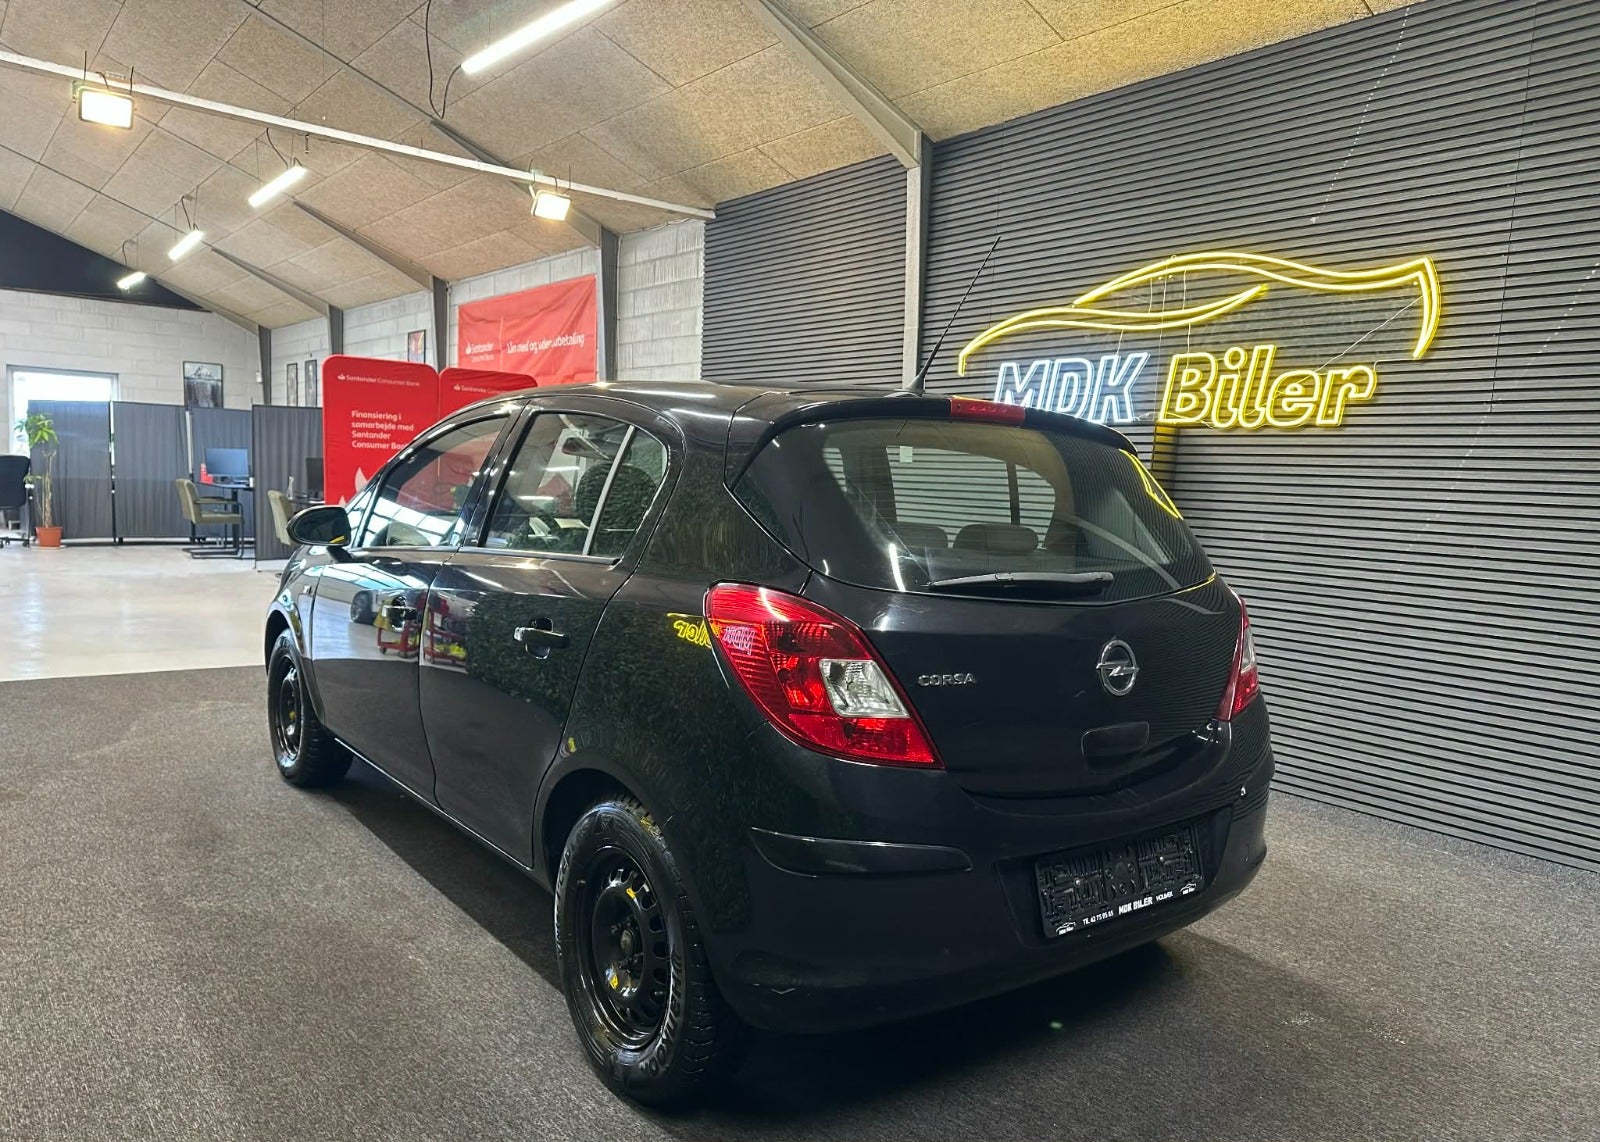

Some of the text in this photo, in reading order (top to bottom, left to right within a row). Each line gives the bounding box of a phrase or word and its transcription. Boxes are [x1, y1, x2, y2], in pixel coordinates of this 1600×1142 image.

[346, 374, 377, 383] Santander
[994, 343, 1378, 429] MDK Biler
[351, 410, 398, 422] Finansiering
[351, 421, 396, 431] samarbejde
[351, 430, 391, 439] Santander
[351, 440, 407, 450] Consumer Ban
[918, 672, 976, 686] CORSA
[1133, 896, 1153, 910] BILER
